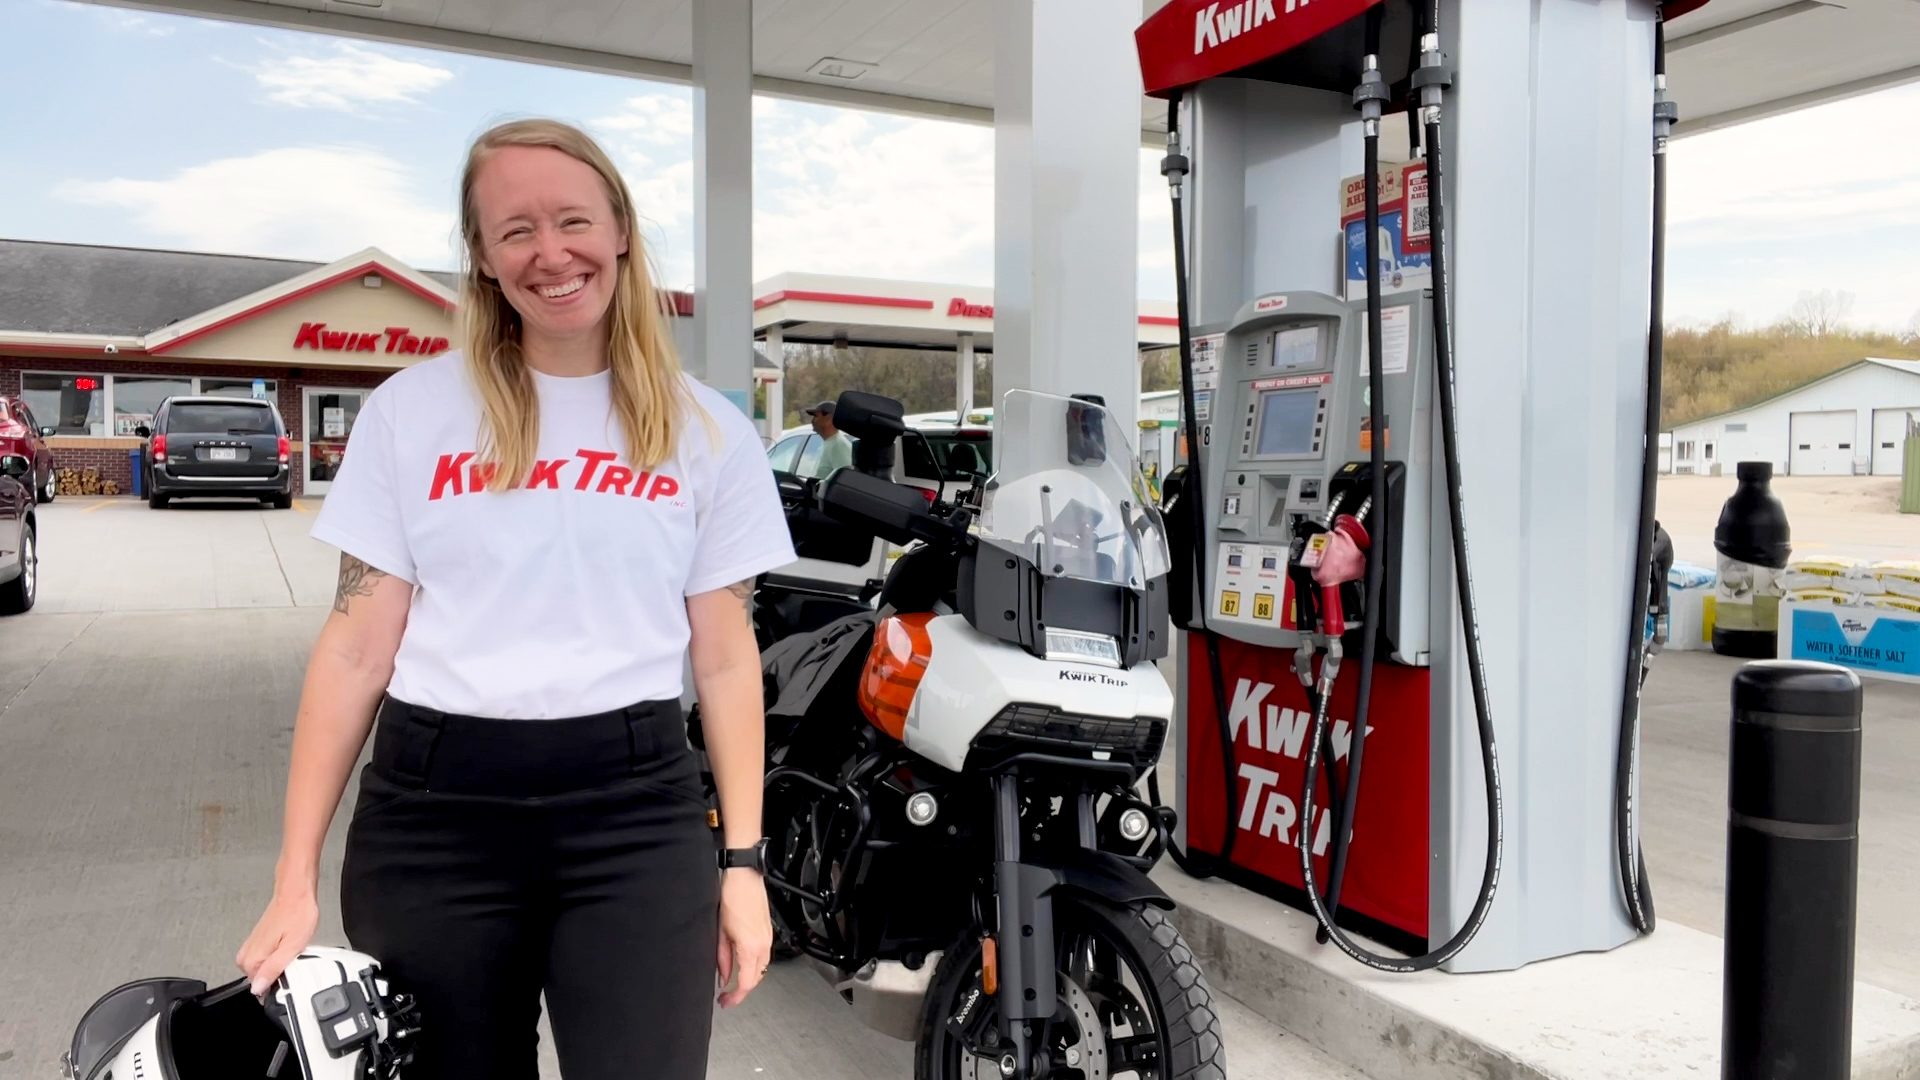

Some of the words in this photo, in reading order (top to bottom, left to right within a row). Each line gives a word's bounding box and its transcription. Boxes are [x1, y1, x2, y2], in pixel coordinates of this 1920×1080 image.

[948, 298, 993, 318] DIES
[293, 322, 382, 352] KWIK
[384, 327, 449, 355] TRIP
[1203, 425, 1211, 446] 8
[428, 451, 570, 501] KWK
[574, 448, 679, 502] TRIP
[1224, 599, 1236, 613] 87
[1258, 602, 1269, 616] 88
[1806, 640, 1834, 654] WATER
[1838, 644, 1881, 660] SOFTENER
[1886, 649, 1906, 663] SALT
[1059, 670, 1097, 683] KWIK
[1099, 674, 1129, 687] TRIP
[956, 989, 980, 1025] brembo
